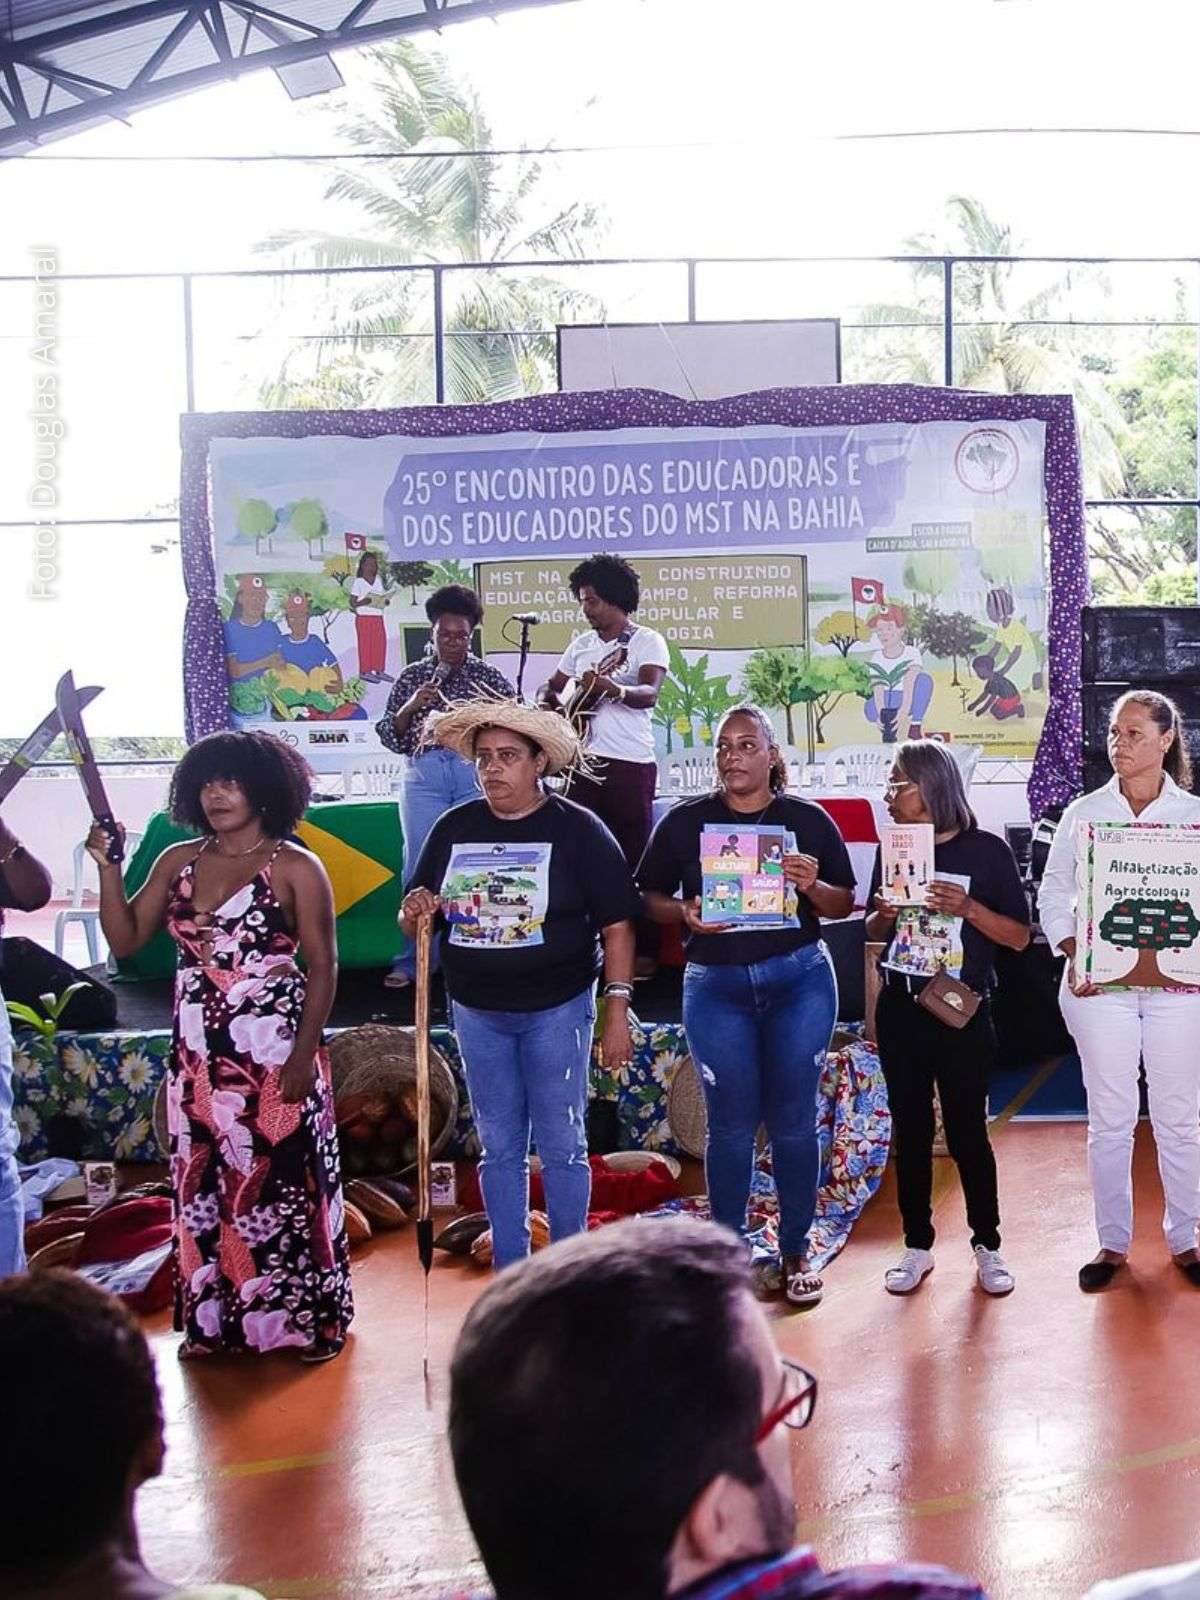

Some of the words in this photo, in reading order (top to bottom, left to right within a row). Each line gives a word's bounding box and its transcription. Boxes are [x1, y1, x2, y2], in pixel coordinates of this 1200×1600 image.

[454, 463, 596, 504] ENCONTRO
[602, 462, 653, 497] DAS
[661, 455, 839, 494] EDUCADORAS
[847, 452, 862, 487] E
[402, 513, 454, 548] DOS
[462, 505, 634, 546] EDUCADORES
[642, 502, 678, 537] DO
[685, 500, 734, 535] MST
[742, 498, 781, 532] NA
[788, 495, 864, 531] BAHIA
[490, 571, 525, 586] MST
[538, 570, 562, 585] NA
[658, 565, 792, 582] CONSTRUINDO
[640, 587, 699, 603] AMPO,
[713, 585, 799, 601] REFORMA
[636, 605, 720, 622] POPULAR
[732, 605, 745, 620] E
[1109, 859, 1198, 877] Alfabetização
[1141, 876, 1149, 886] e
[1104, 883, 1191, 900] Agroecologia
